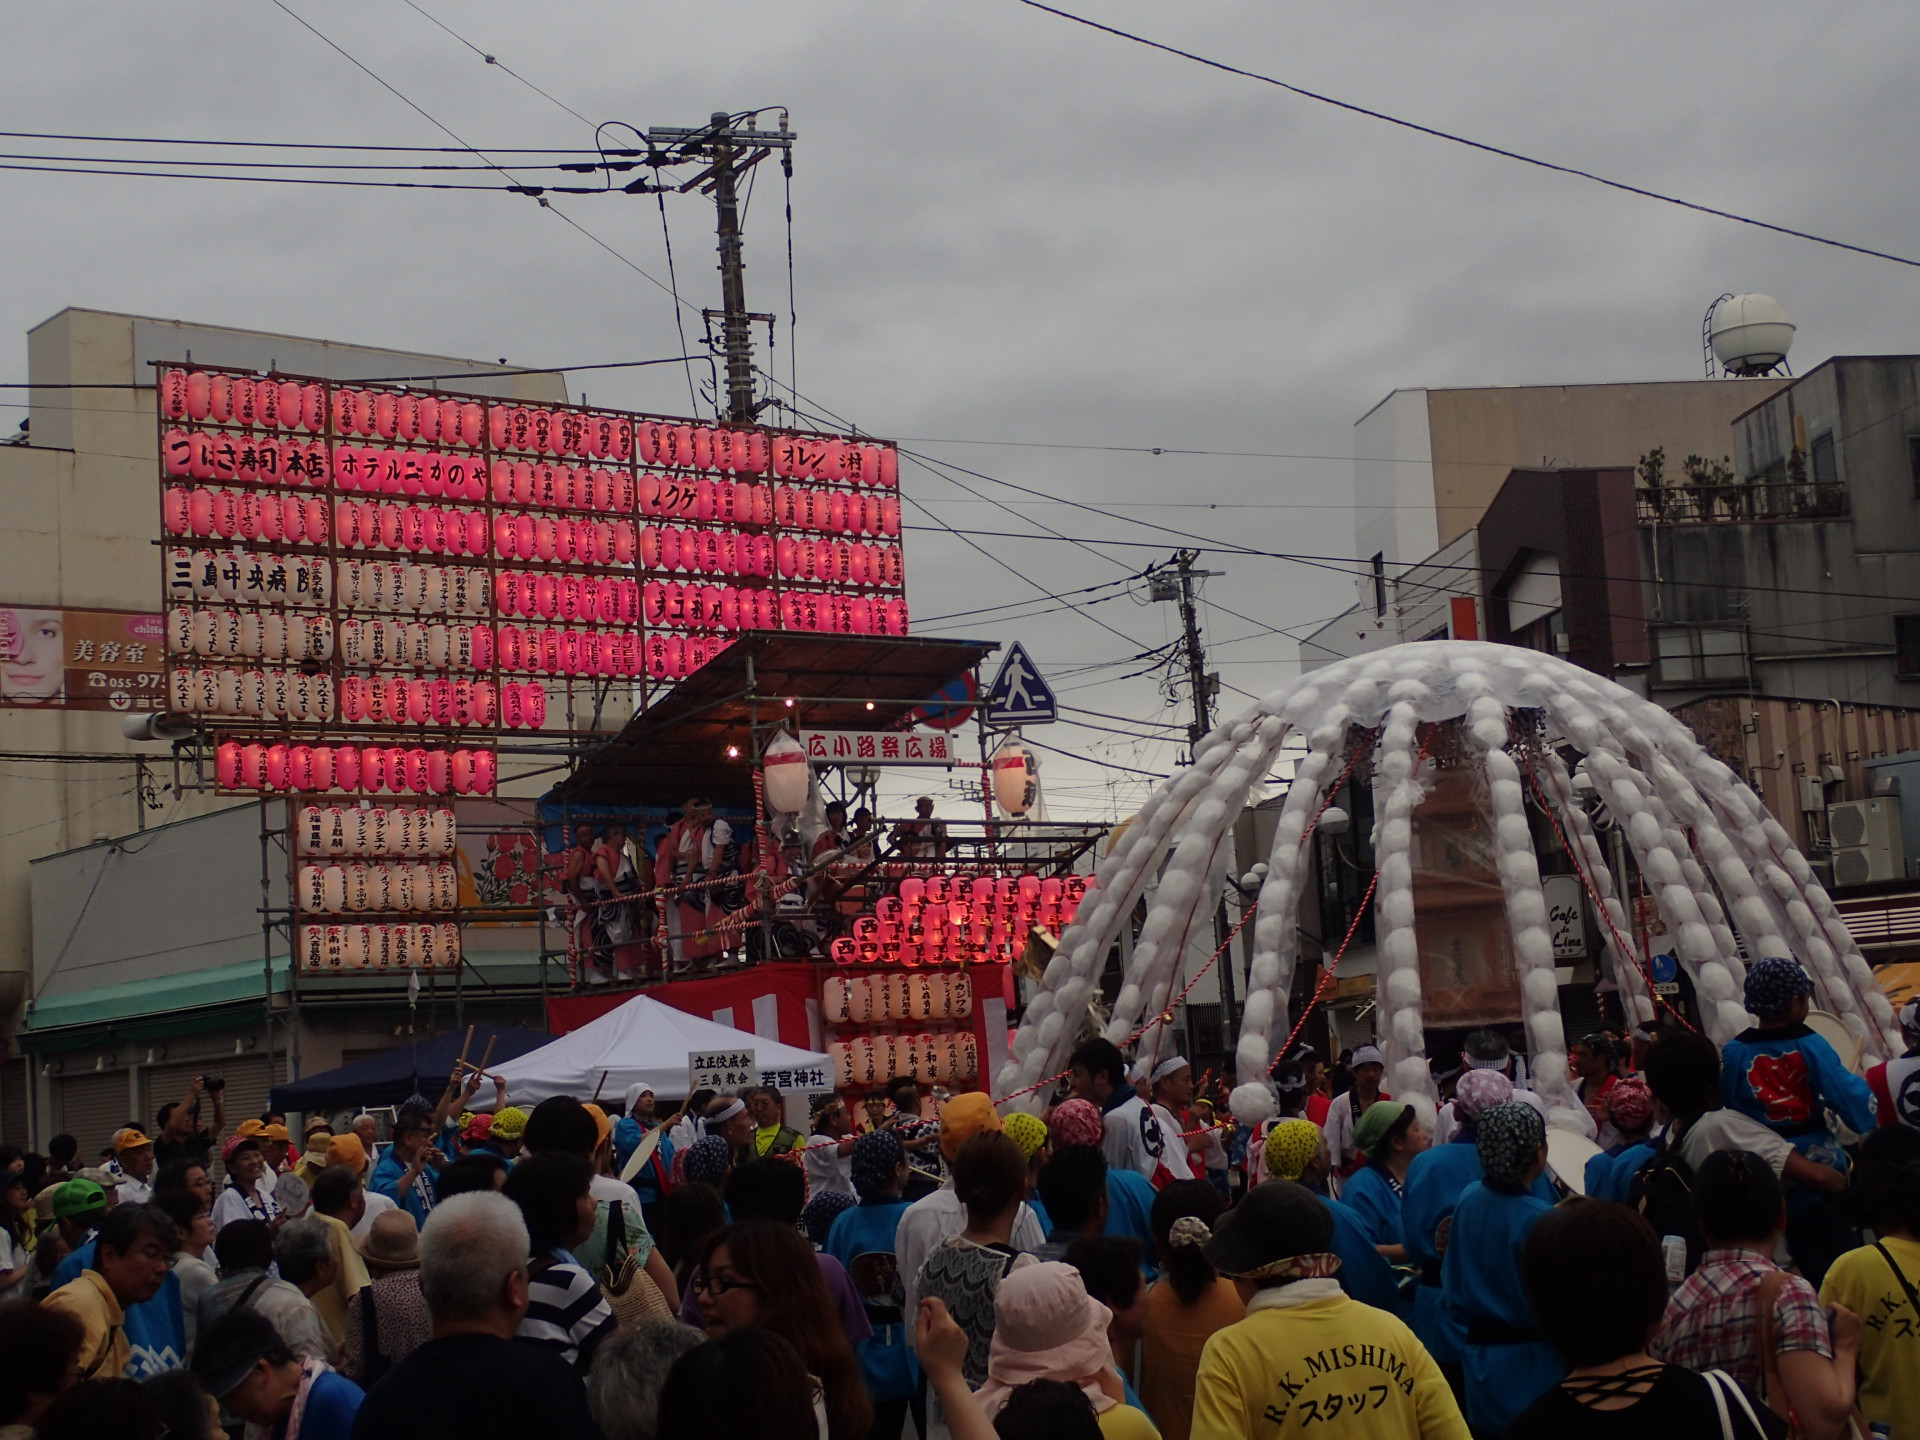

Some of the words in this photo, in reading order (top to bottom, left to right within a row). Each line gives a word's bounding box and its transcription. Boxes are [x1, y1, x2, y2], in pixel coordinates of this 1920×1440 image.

[725, 488, 734, 517] 安田屋
[134, 624, 164, 634] chiffo
[804, 600, 816, 629] 如来寺
[840, 603, 852, 633] 如来寺
[876, 605, 888, 634] 如来寺
[179, 619, 192, 648] うなよし
[208, 621, 217, 652] うなよし
[228, 620, 240, 652] うなよし
[73, 639, 147, 665] 美容室
[459, 634, 470, 665] 山田板金
[567, 638, 577, 670] MISTY
[590, 639, 599, 670] JEET
[612, 641, 621, 672] JEET
[623, 641, 635, 672] JEET
[177, 676, 190, 707] うなよし
[203, 678, 215, 707] うなよし
[234, 679, 243, 709] うなよし
[256, 680, 266, 711] うなよし
[276, 680, 288, 711] うなよし
[297, 681, 309, 713] うなよし
[317, 681, 330, 713] うなよし
[456, 687, 468, 719] 地中海
[808, 734, 948, 760] 広小路祭広場
[1549, 905, 1579, 925] Cafe
[1560, 925, 1570, 934] de
[1553, 933, 1583, 948] Lima
[954, 982, 967, 1015] カジワラ
[694, 1053, 752, 1070] 立正佼成会
[699, 1071, 749, 1086] 三島教会
[761, 1069, 825, 1088] 若宮神社
[1894, 1318, 1920, 1338] ス
[1263, 1343, 1416, 1426] R.K.MISHIMA
[1299, 1384, 1389, 1428] スタッフ
